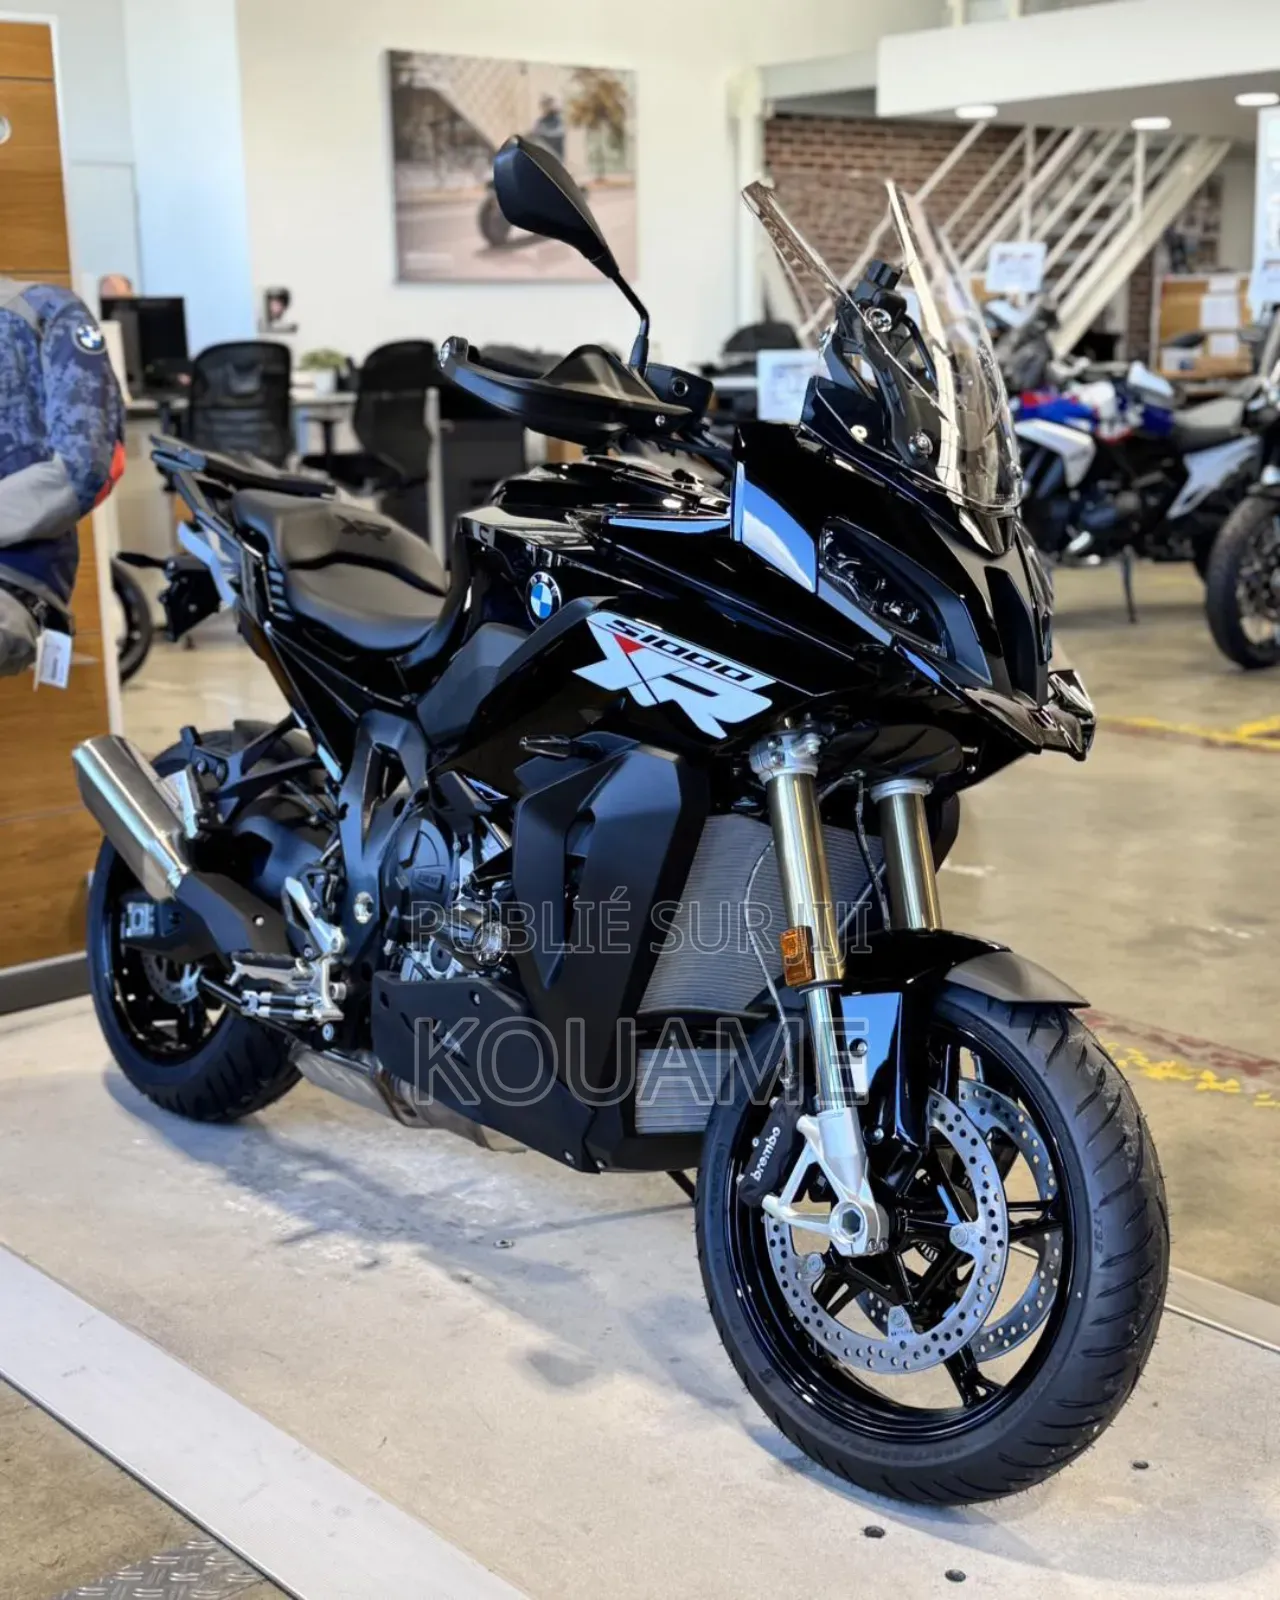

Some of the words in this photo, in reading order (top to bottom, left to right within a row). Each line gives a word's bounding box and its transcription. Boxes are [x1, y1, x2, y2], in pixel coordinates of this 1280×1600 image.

[571, 612, 773, 740] XR
[606, 619, 754, 682] S1000
[750, 1126, 781, 1182] brembo
